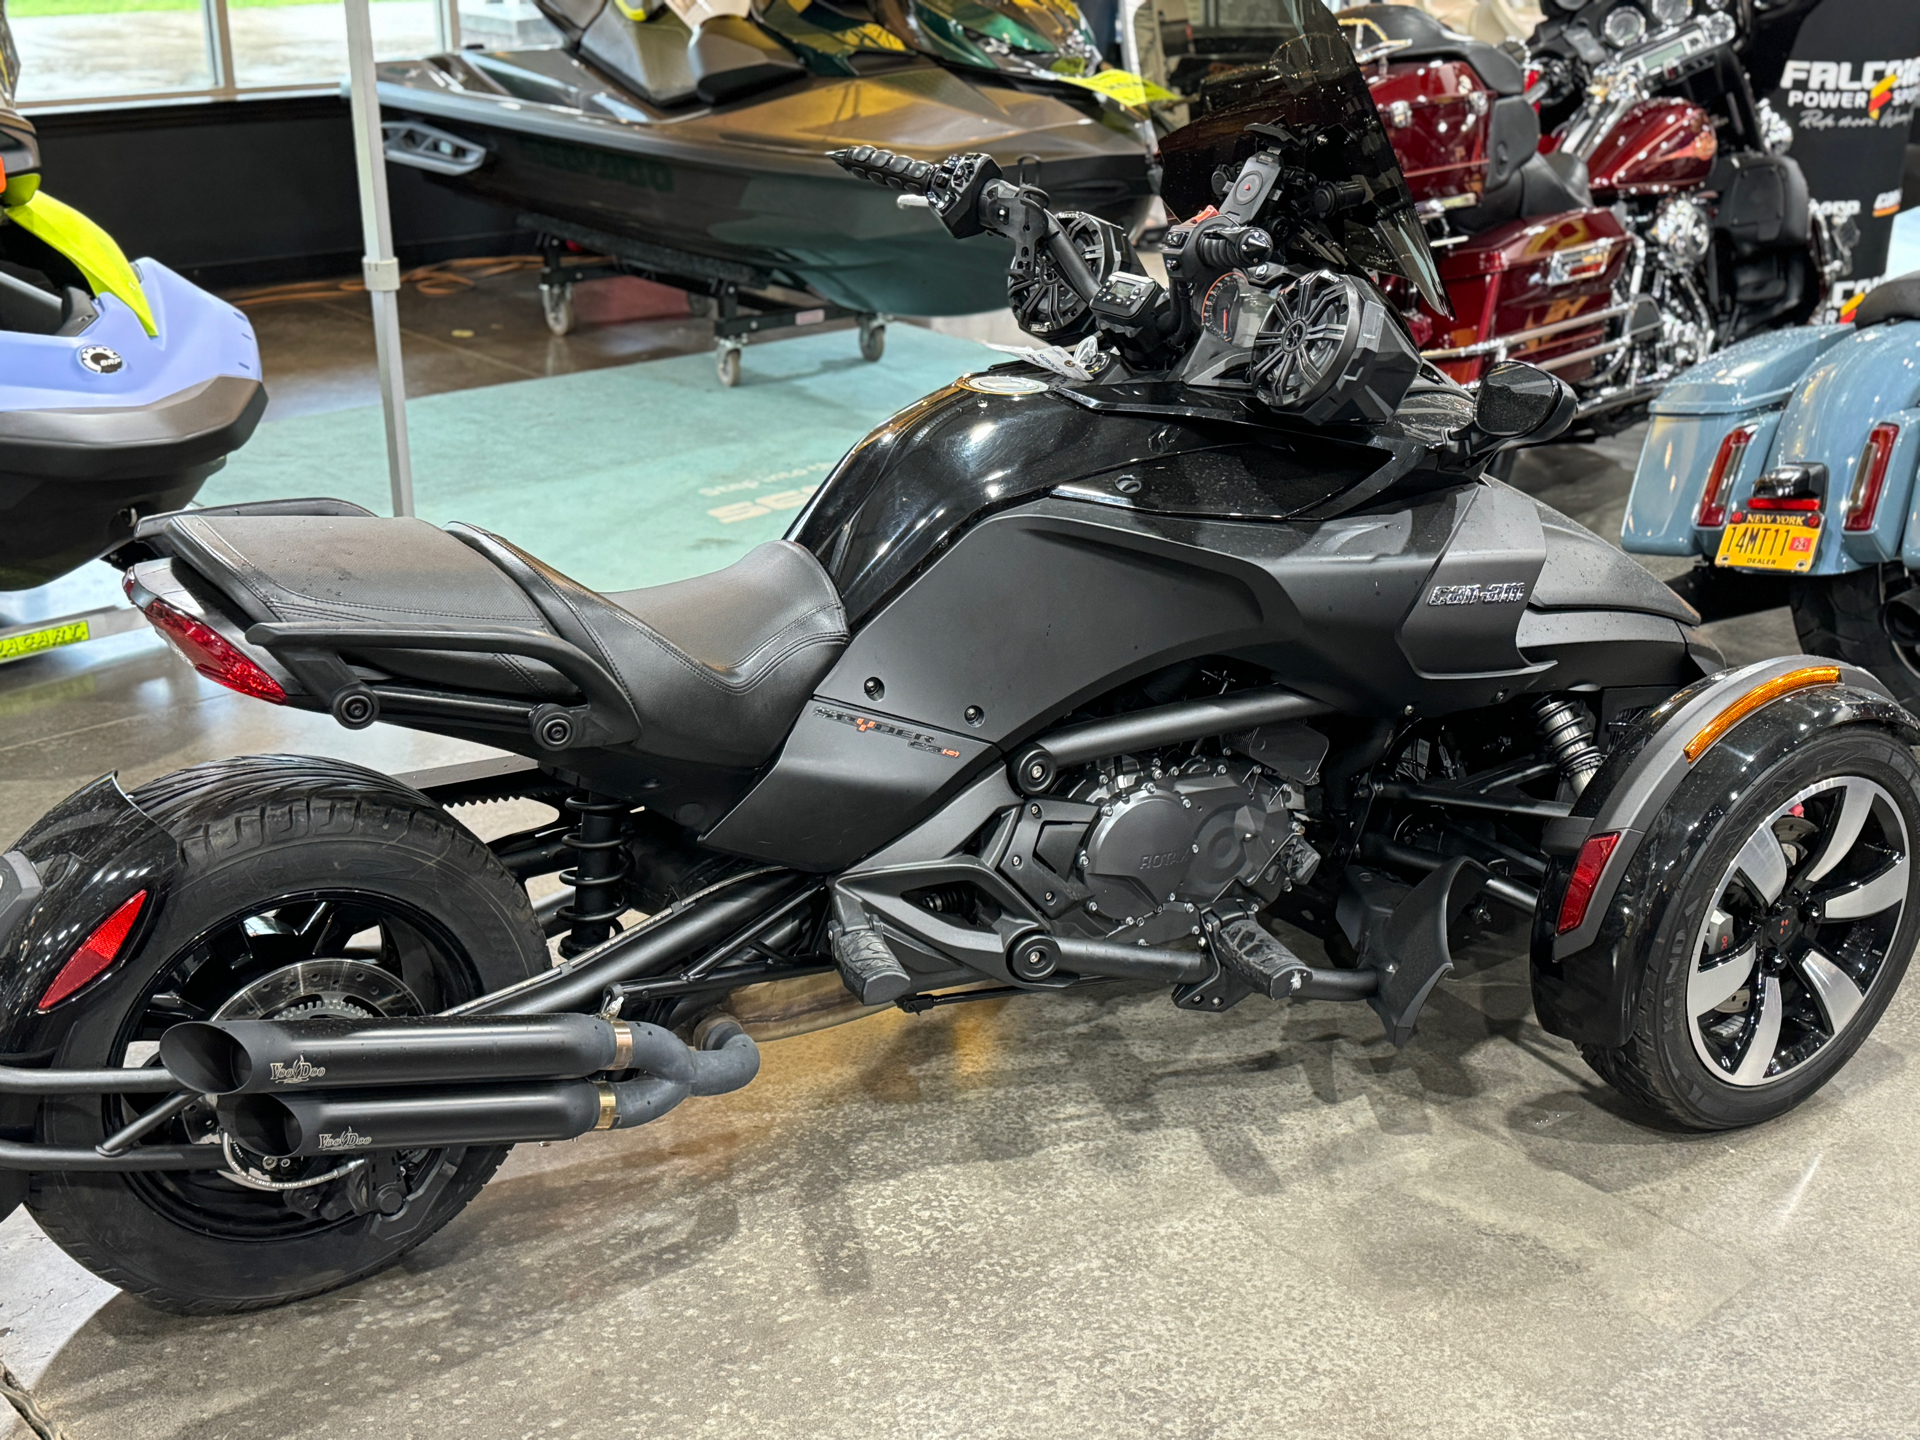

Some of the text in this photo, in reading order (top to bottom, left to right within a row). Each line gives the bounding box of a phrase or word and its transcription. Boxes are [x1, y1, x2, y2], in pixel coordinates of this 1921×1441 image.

[1787, 90, 1868, 109] POWER
[100, 357, 122, 367] BRP
[1746, 513, 1806, 526] NEW YORK
[1726, 525, 1791, 557] 14MT11
[1746, 557, 1777, 566] DEALER
